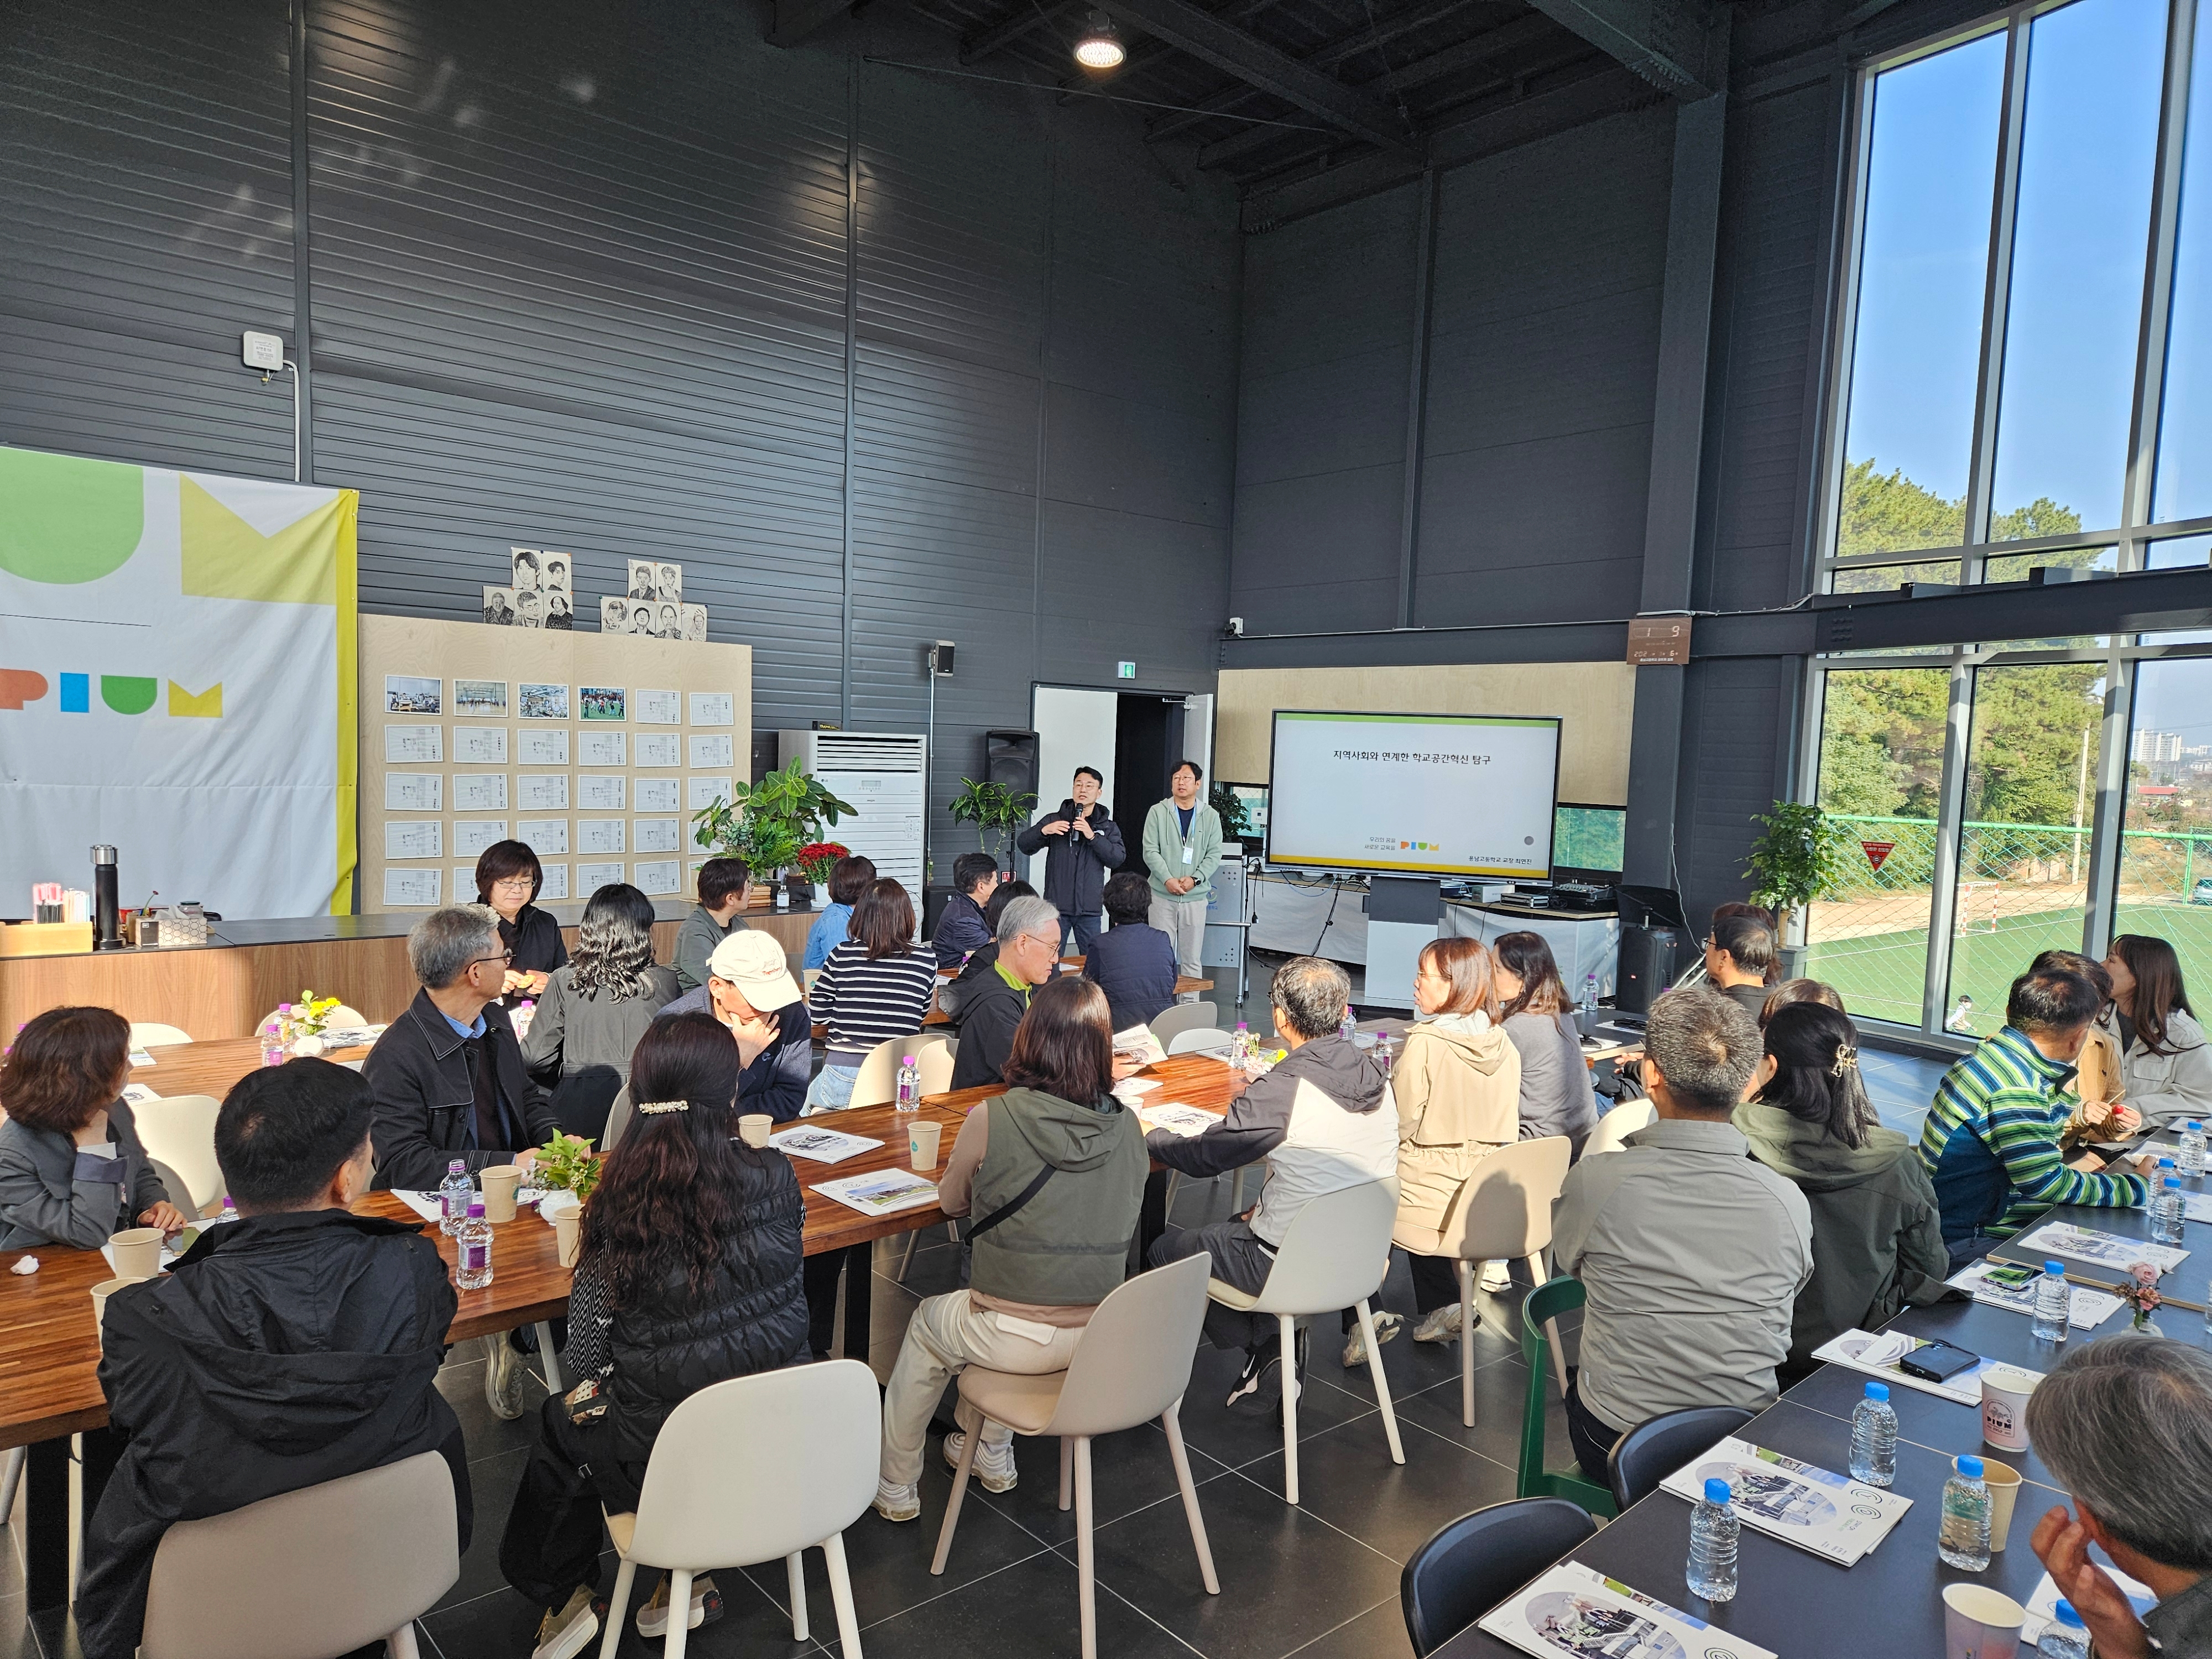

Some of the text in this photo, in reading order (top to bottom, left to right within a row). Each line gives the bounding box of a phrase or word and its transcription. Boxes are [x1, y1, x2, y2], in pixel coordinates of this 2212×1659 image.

[1333, 750, 1491, 765] 지역사회와 연계한 학교공간혁신 탐구
[1400, 841, 1439, 851] PIUM
[1987, 1416, 2012, 1430] PIUM
